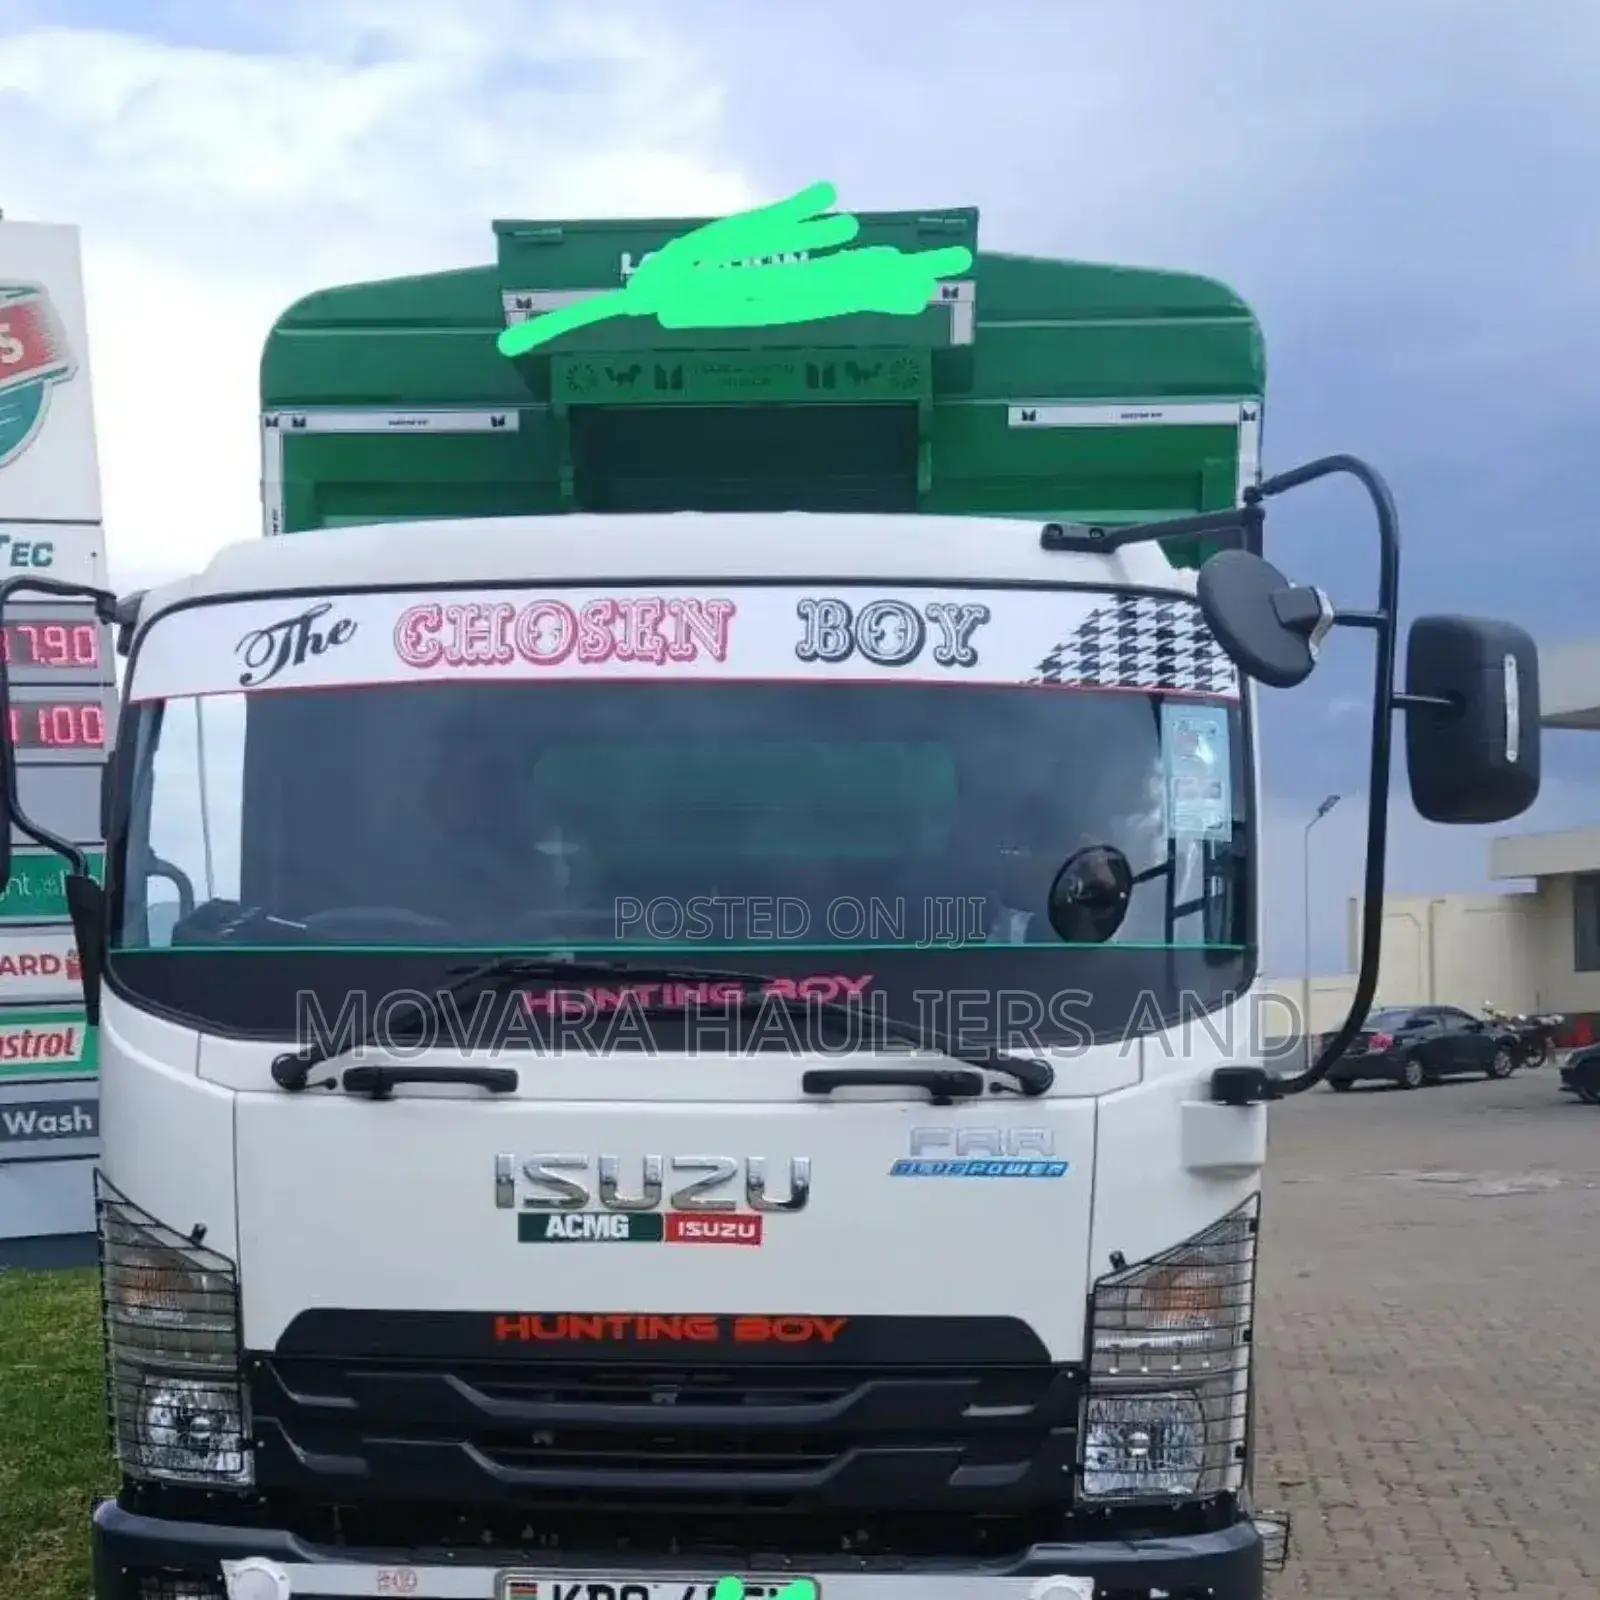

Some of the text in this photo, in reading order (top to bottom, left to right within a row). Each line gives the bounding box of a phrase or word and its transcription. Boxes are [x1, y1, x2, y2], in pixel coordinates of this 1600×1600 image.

[235, 598, 990, 687] The CHOSEN BOY
[4, 1106, 93, 1136] Wash
[495, 1153, 811, 1212] ISUZU
[544, 1214, 629, 1240] ACMG
[678, 1220, 756, 1238] ISUZU
[494, 1315, 848, 1343] HUNTING BOY
